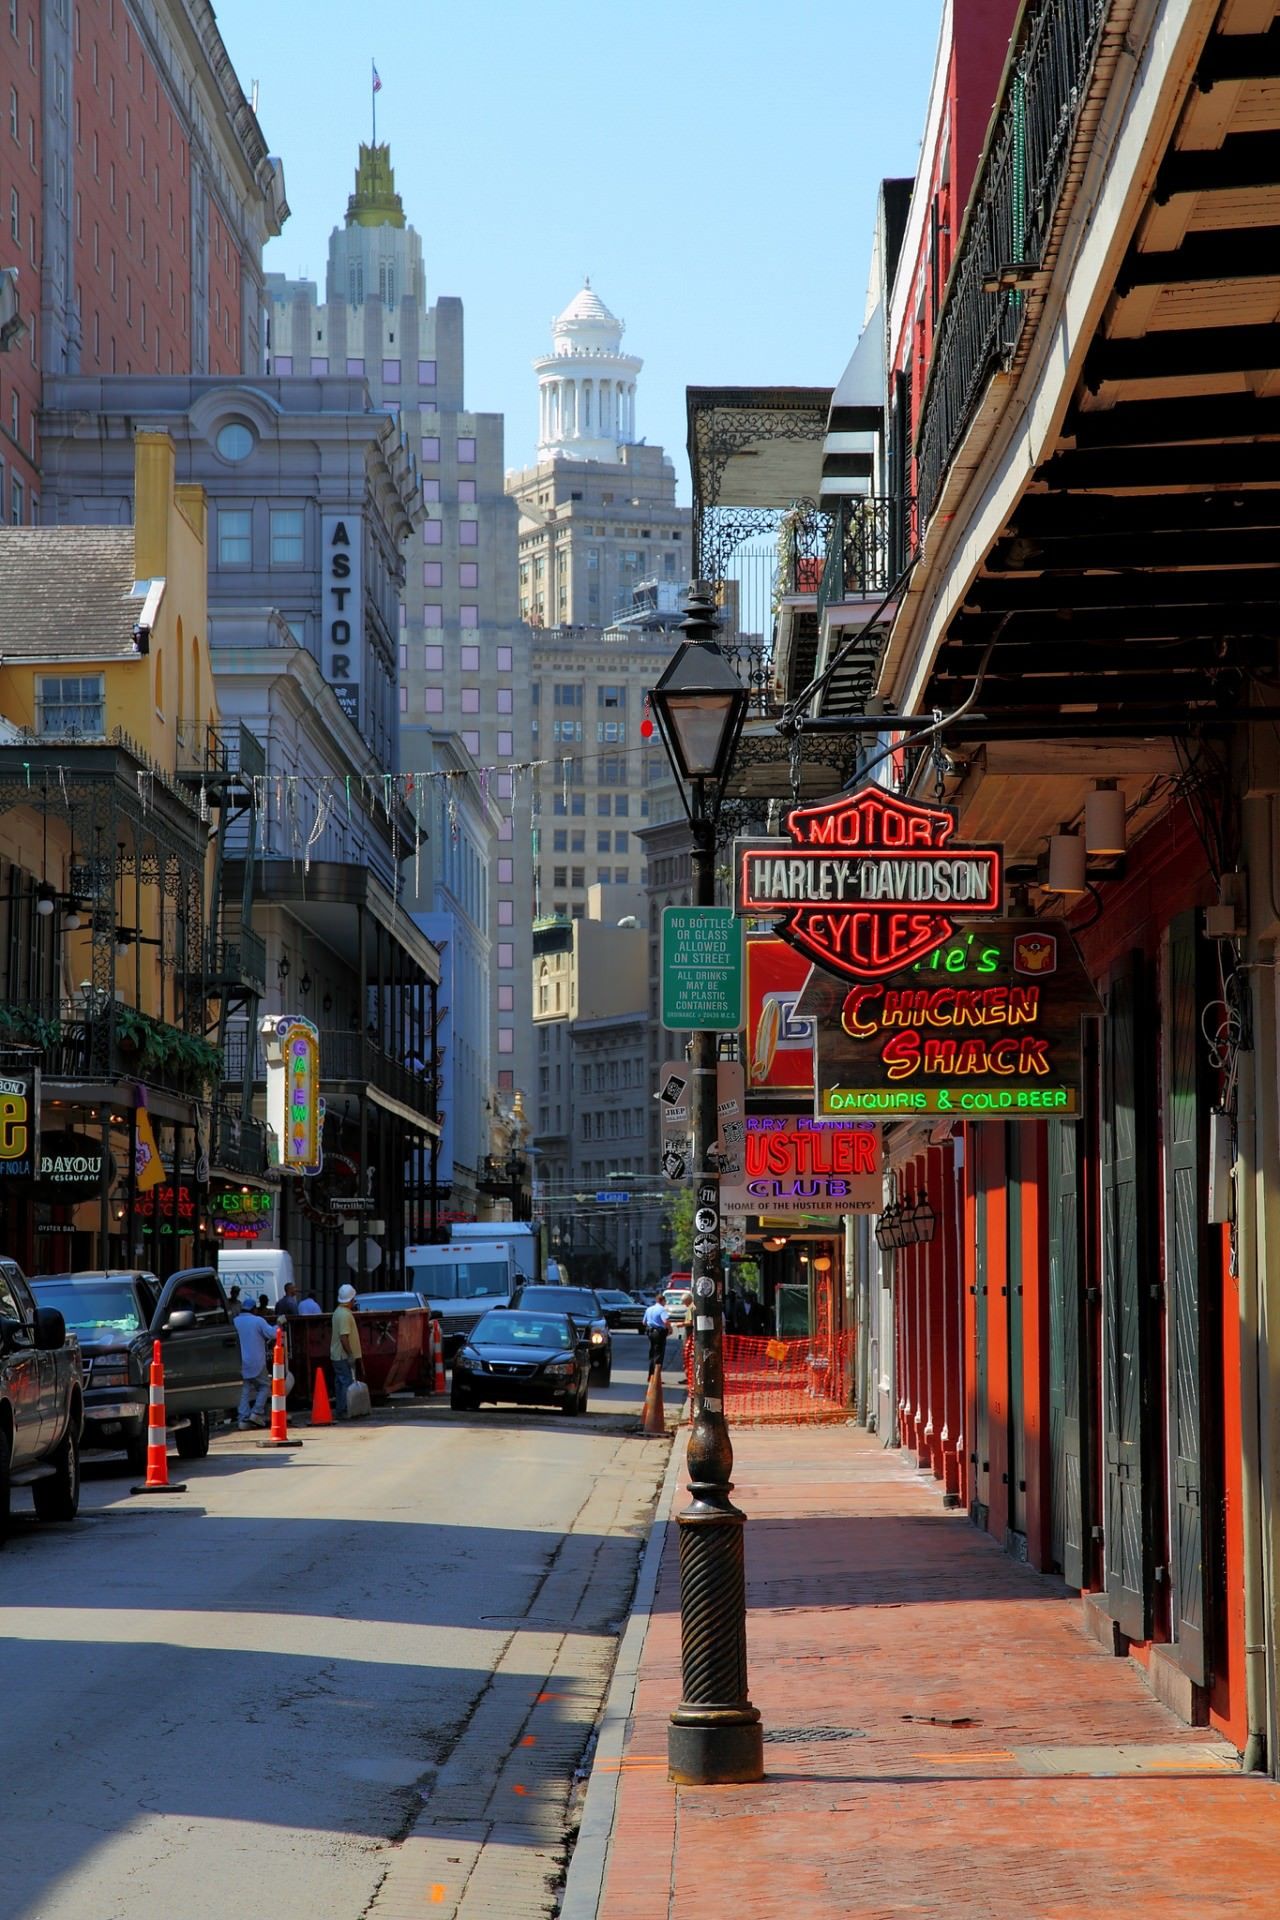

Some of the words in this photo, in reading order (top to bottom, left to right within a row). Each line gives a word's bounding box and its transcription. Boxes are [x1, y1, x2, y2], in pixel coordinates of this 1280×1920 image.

[331, 521, 351, 679] ASTOR
[810, 800, 932, 846] MOTOR
[754, 859, 990, 900] HARLEY-DAVIDSON
[671, 918, 685, 928] NO
[689, 918, 734, 929] BOTTLES
[677, 930, 690, 940] OR
[695, 930, 728, 940] GLASS
[809, 912, 932, 965] CYCLES
[679, 942, 727, 952] ALLOWED
[674, 953, 688, 963] ON
[692, 953, 731, 964] STREET
[677, 971, 692, 980] ALL
[696, 971, 728, 980] DRINKS
[686, 981, 704, 990] MAY
[707, 981, 719, 990] BE
[679, 991, 688, 1000] IN
[691, 991, 726, 1000] PLASTIC
[675, 1001, 728, 1011] CONTAINERS
[841, 982, 1040, 1038] CHICKEN
[882, 1030, 1050, 1080] SHACK
[291, 1040, 308, 1155] GATEWAY
[830, 1092, 927, 1110] DAIQUIRIS
[936, 1089, 953, 1110] &
[961, 1092, 1012, 1109] COLD
[1017, 1090, 1067, 1107] BEER
[41, 1157, 102, 1173] BAYOU
[747, 1179, 852, 1198] CLUB
[758, 1202, 769, 1210] OF
[773, 1202, 789, 1210] THE
[792, 1202, 832, 1210] HUSTLER
